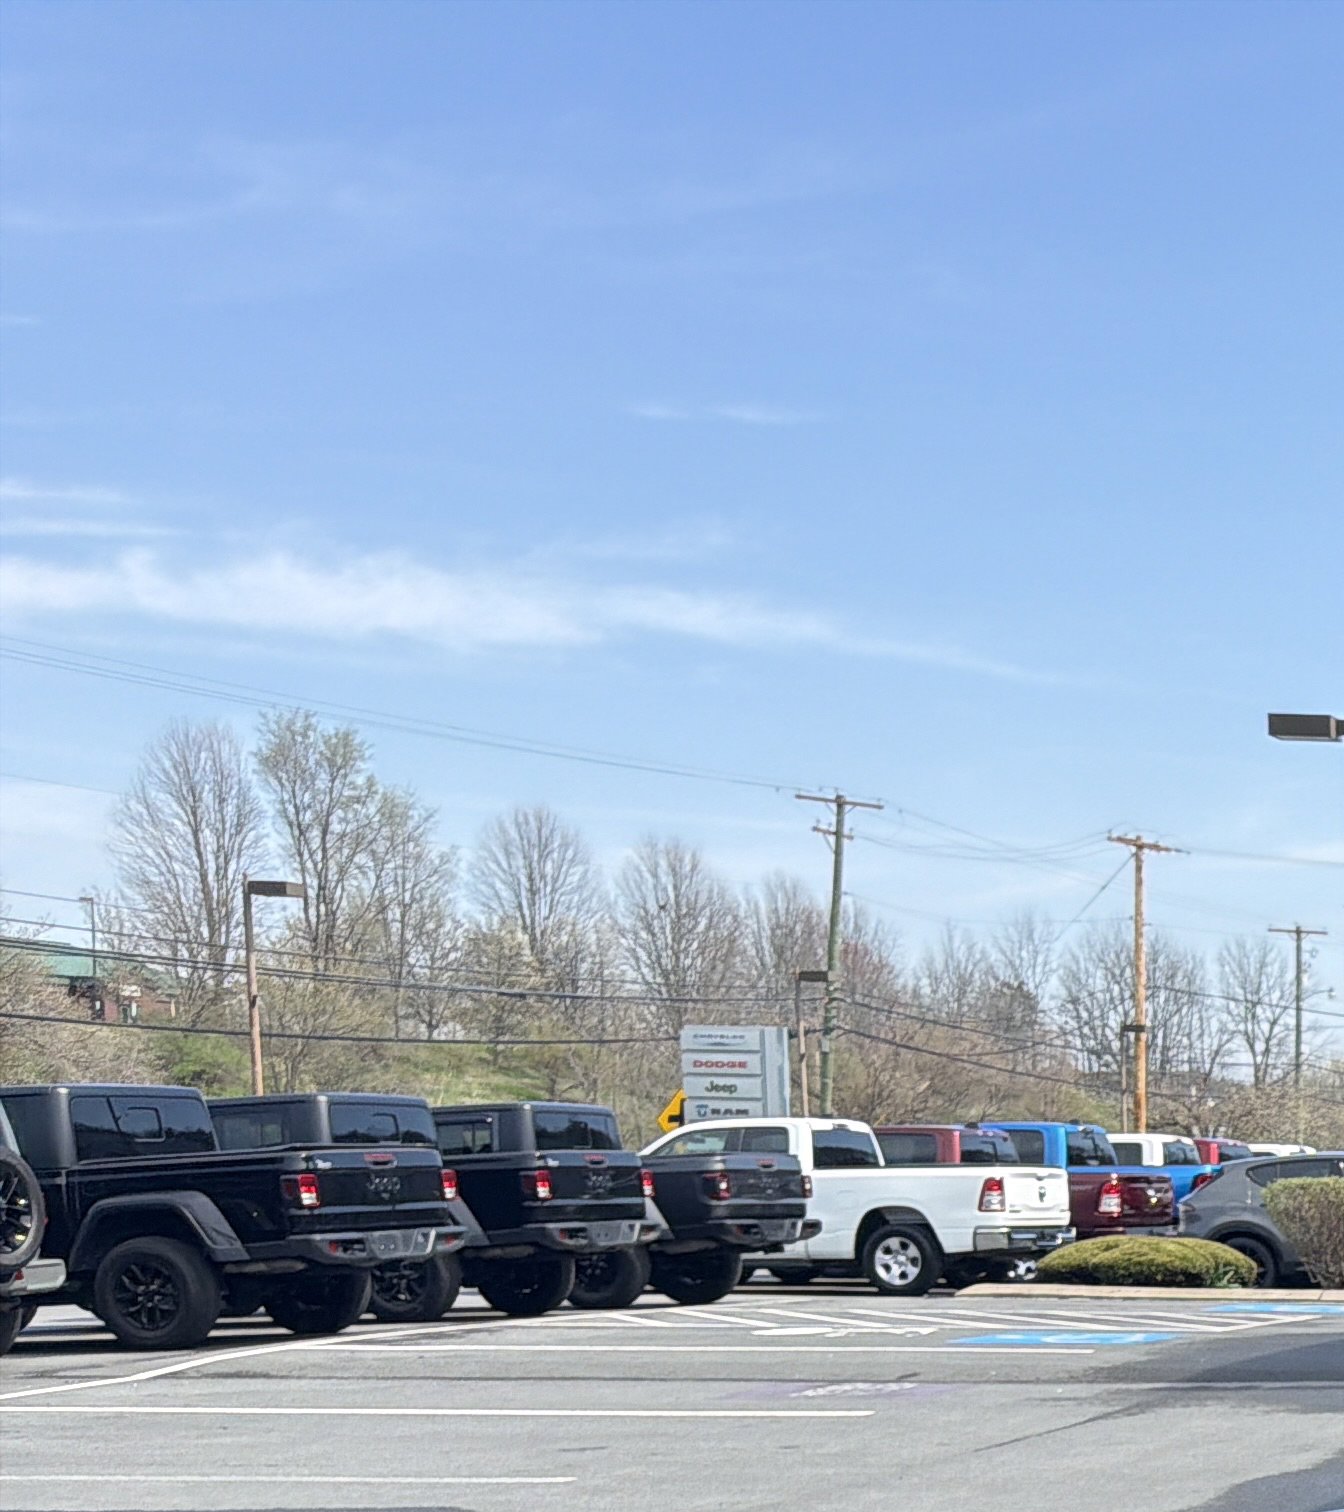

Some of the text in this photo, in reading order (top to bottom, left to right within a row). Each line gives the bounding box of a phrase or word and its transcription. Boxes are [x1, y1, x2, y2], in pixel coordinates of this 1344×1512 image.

[692, 1060, 748, 1069] DODGE
[705, 1080, 738, 1094] Jeep
[710, 1108, 749, 1116] RAM
